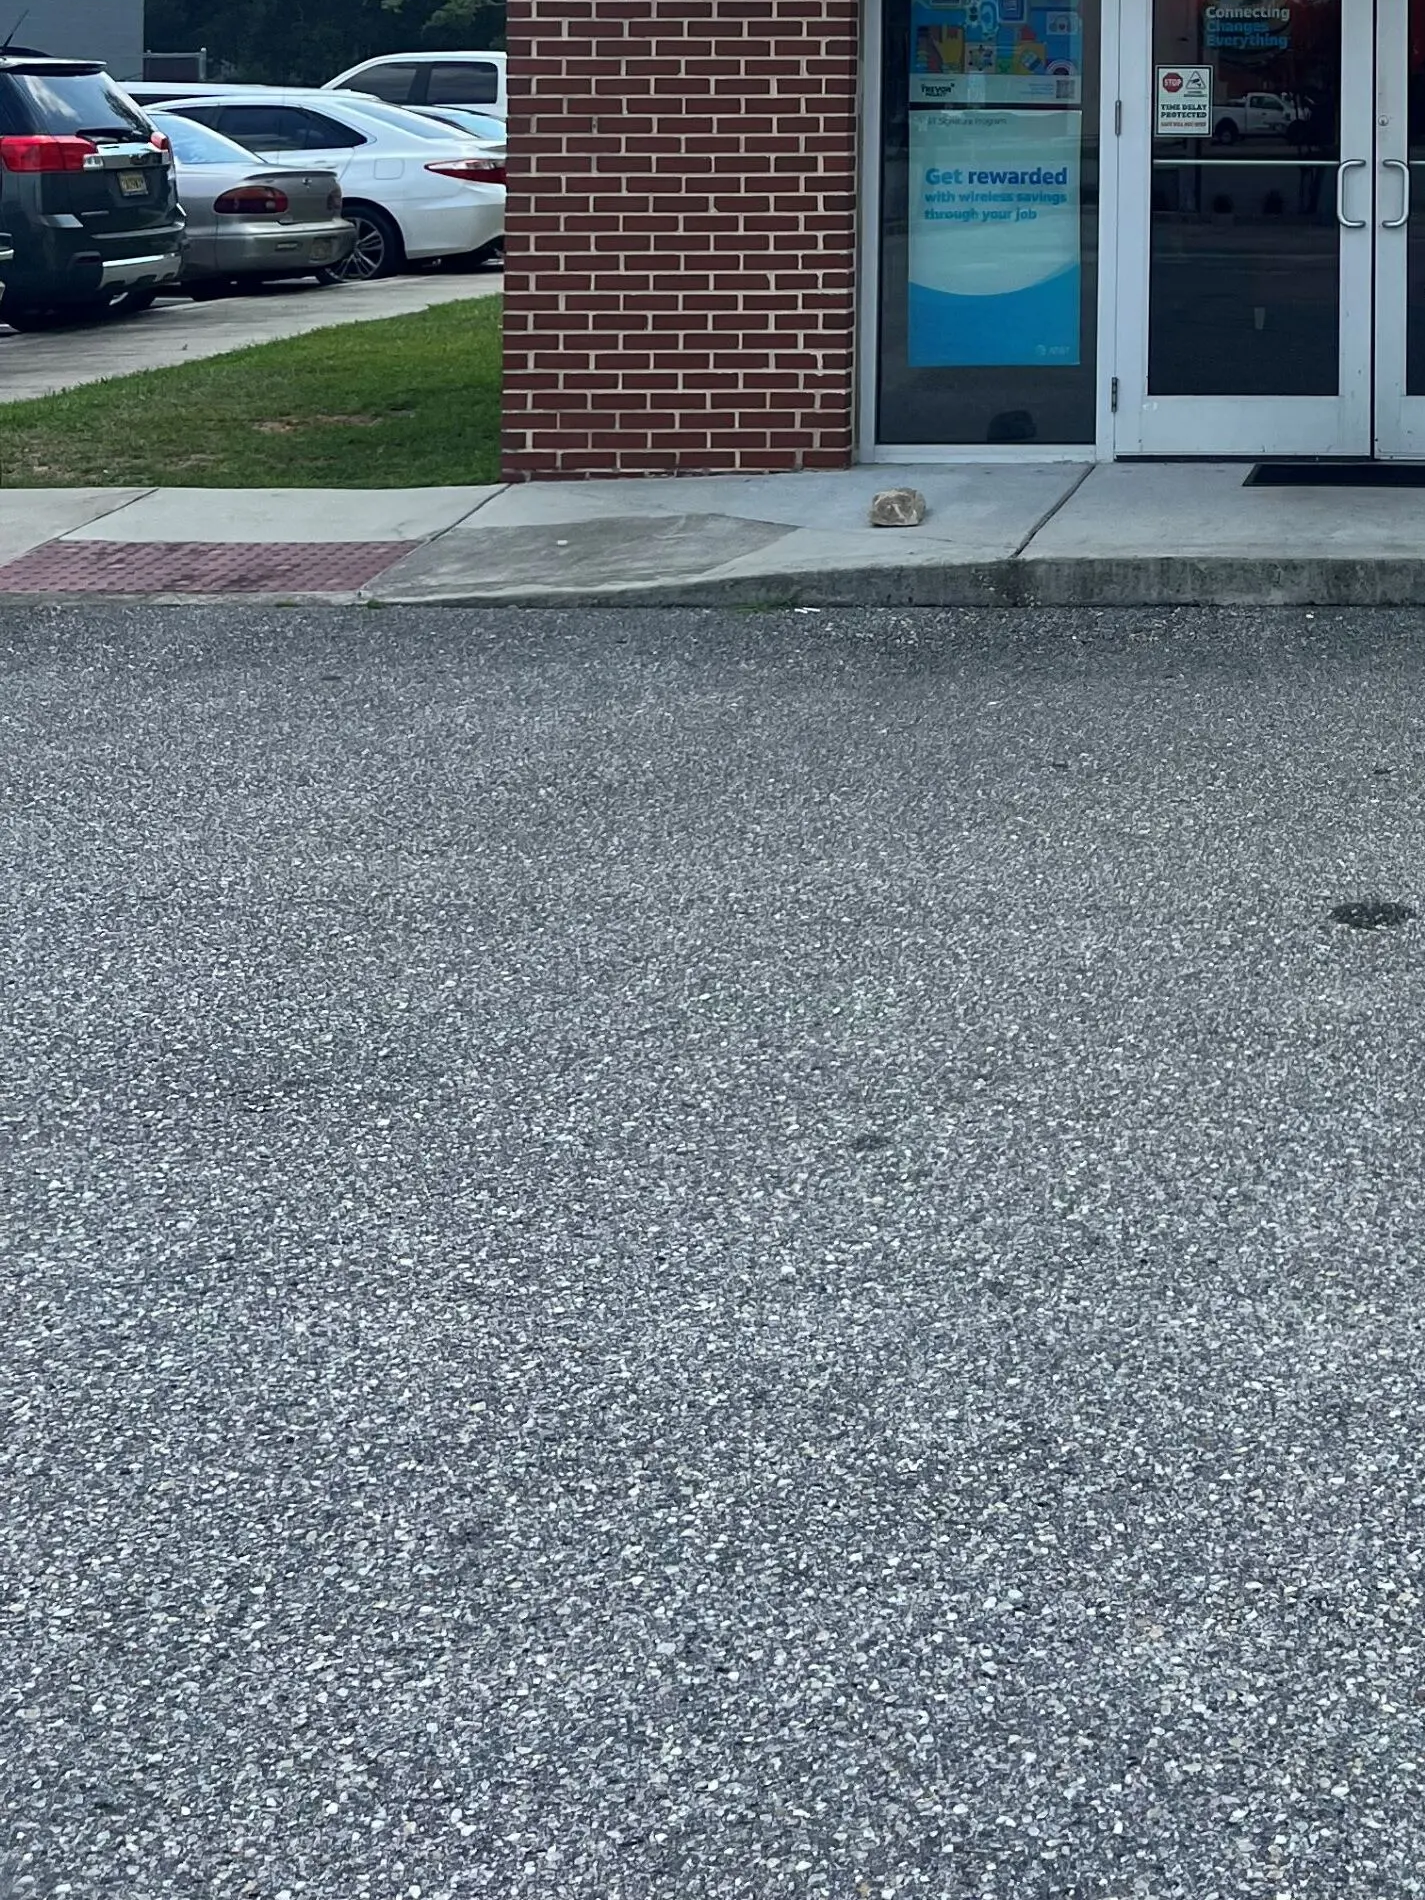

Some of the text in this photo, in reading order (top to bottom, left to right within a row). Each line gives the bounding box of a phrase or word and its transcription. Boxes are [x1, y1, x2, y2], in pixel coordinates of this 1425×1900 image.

[1205, 6, 1290, 21] Connecting
[1206, 21, 1269, 34] Changes
[1206, 33, 1288, 50] Everything
[1163, 78, 1182, 87] STOP
[1160, 103, 1207, 111] TIME DELAY
[925, 167, 1068, 186] Get rewarded
[925, 191, 1067, 206] with wireless savings
[925, 208, 1037, 223] through your job
